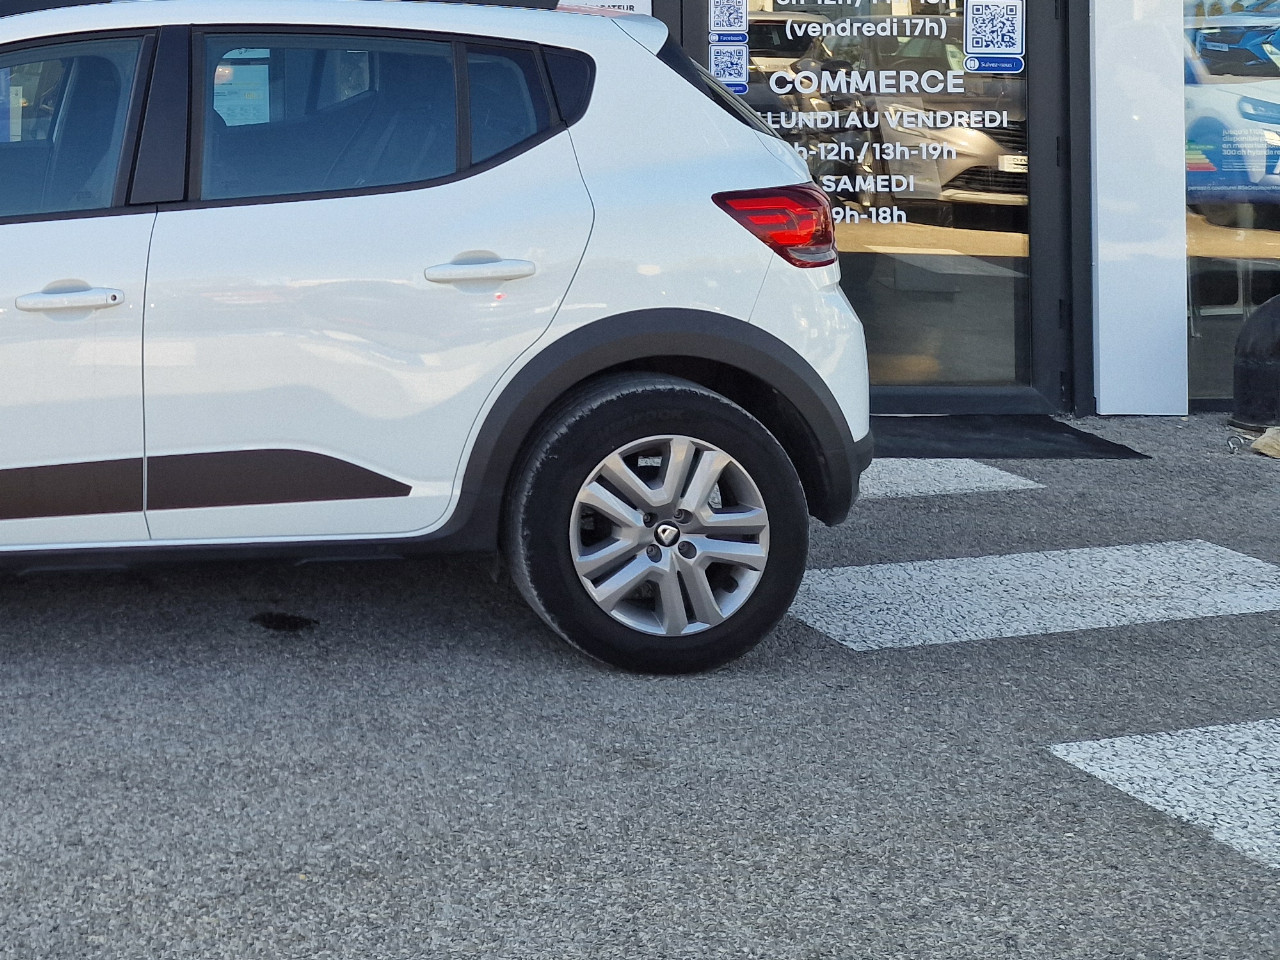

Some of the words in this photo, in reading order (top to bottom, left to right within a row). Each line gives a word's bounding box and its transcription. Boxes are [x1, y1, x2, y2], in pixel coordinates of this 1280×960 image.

[785, 18, 899, 39] (vendredi
[902, 17, 948, 39] 17h)
[769, 70, 966, 93] COMMERCE
[767, 111, 840, 129] LUNDI
[844, 111, 880, 129] AU
[884, 110, 1009, 128] VENDREDI
[794, 142, 855, 160] h-12h
[872, 142, 958, 161] 13h-19h
[821, 174, 915, 193] SAMEDI
[831, 206, 908, 225] 9h-18h
